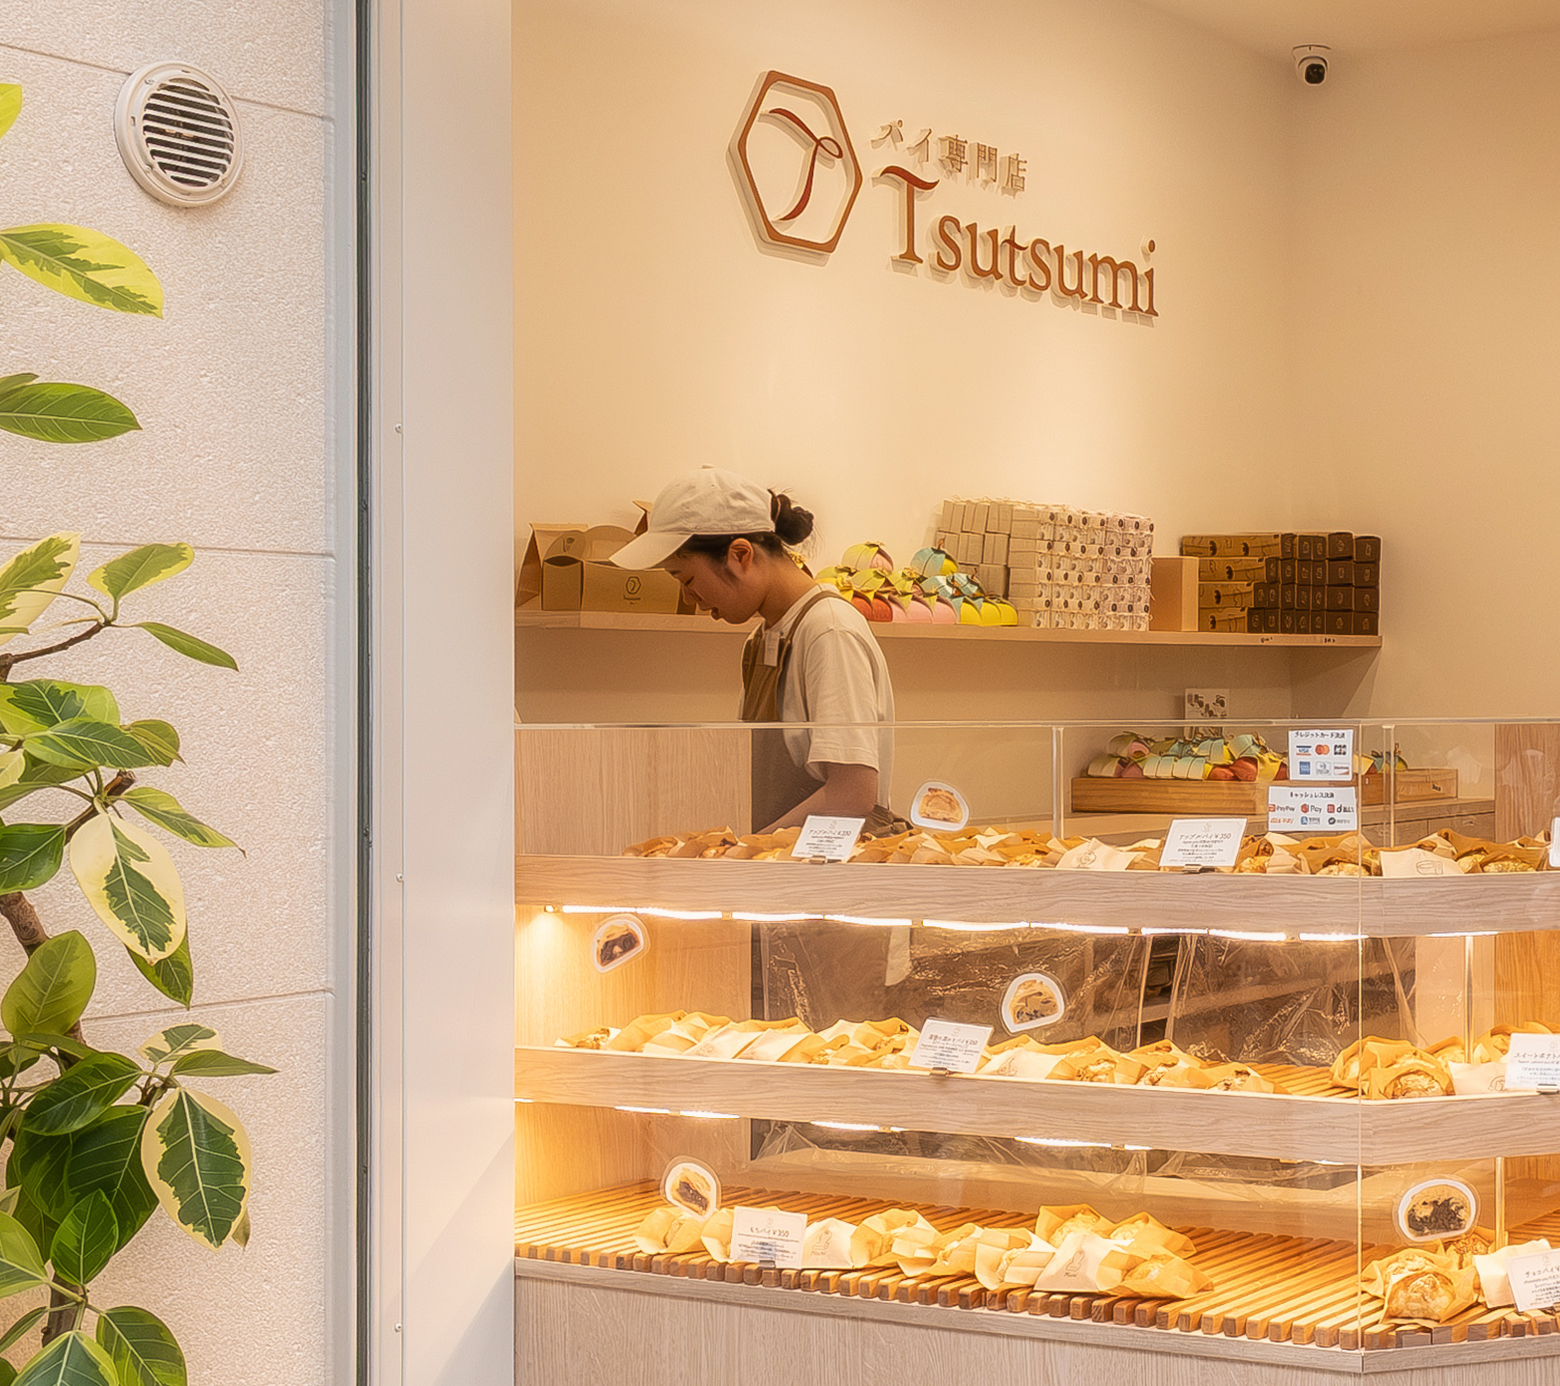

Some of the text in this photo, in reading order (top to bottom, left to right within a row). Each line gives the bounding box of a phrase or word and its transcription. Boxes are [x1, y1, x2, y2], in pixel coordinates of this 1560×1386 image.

[870, 118, 1029, 197] パイ専門店
[878, 164, 1159, 318] Tsutsumi
